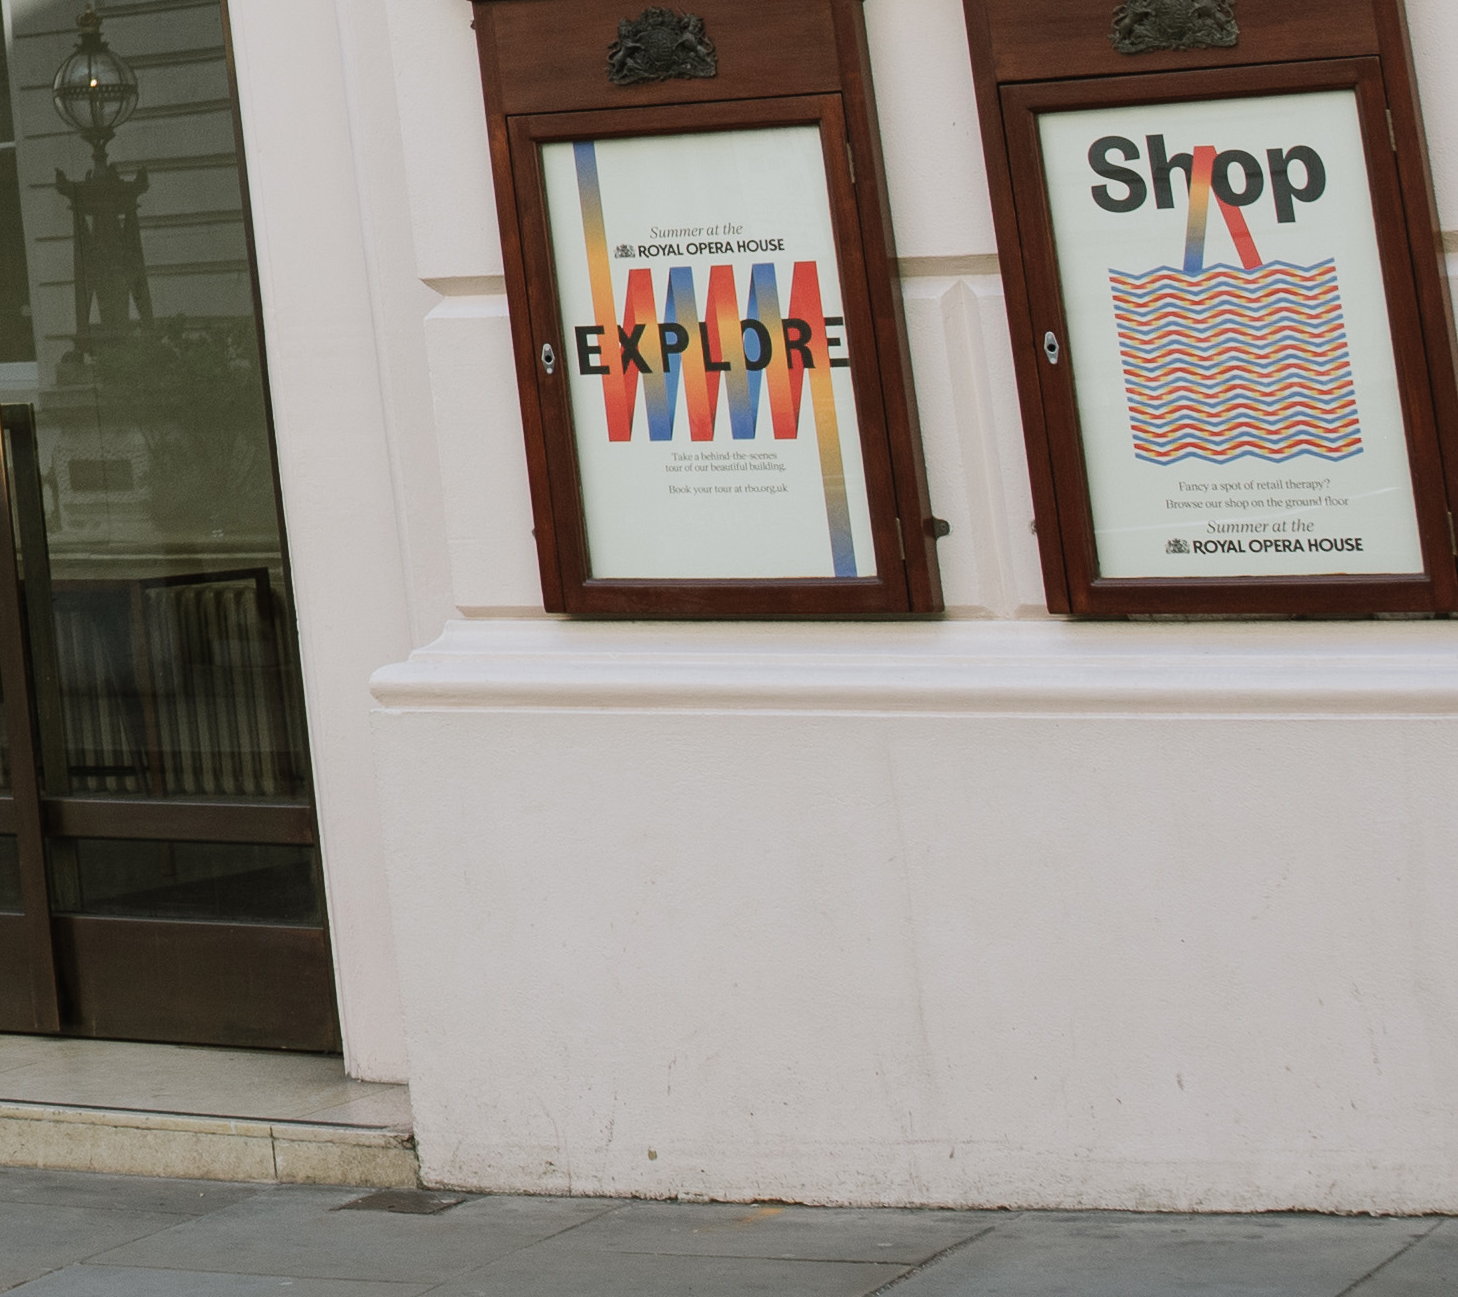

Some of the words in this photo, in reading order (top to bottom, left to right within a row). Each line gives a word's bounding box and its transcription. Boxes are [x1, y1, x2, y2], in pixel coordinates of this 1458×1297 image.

[1087, 134, 1327, 224] Shop
[650, 226, 705, 239] Summer
[706, 224, 720, 236] at
[723, 222, 743, 235] the
[638, 243, 684, 258] ROYAL
[686, 241, 735, 255] OPERA
[737, 238, 785, 253] HOUSE
[574, 316, 851, 375] EXPLORE
[672, 452, 693, 461] Take
[701, 451, 778, 461] behind-the-scenes
[665, 464, 682, 472] tour
[685, 463, 693, 471] of
[710, 462, 748, 472] beautiful
[668, 485, 691, 494] Book
[693, 486, 713, 496] your
[714, 485, 732, 493] tour
[734, 485, 742, 493] at
[1179, 481, 1208, 493] Fancy
[1220, 482, 1242, 493] spot
[1244, 480, 1254, 490] of
[1256, 479, 1283, 490] retail
[1285, 478, 1331, 491] therapy?
[1165, 498, 1203, 510] Browse
[1205, 500, 1222, 509] our
[1224, 497, 1249, 511] shop
[1250, 500, 1265, 508] on
[1266, 497, 1283, 508] the
[1285, 496, 1322, 510] ground
[1324, 495, 1349, 507] floor
[1206, 520, 1269, 534] Summer
[1272, 520, 1287, 533] at
[1291, 518, 1314, 532] the
[1192, 539, 1246, 555] ROYAL
[1249, 538, 1305, 553] OPERA
[1307, 537, 1363, 552] HOUSE
